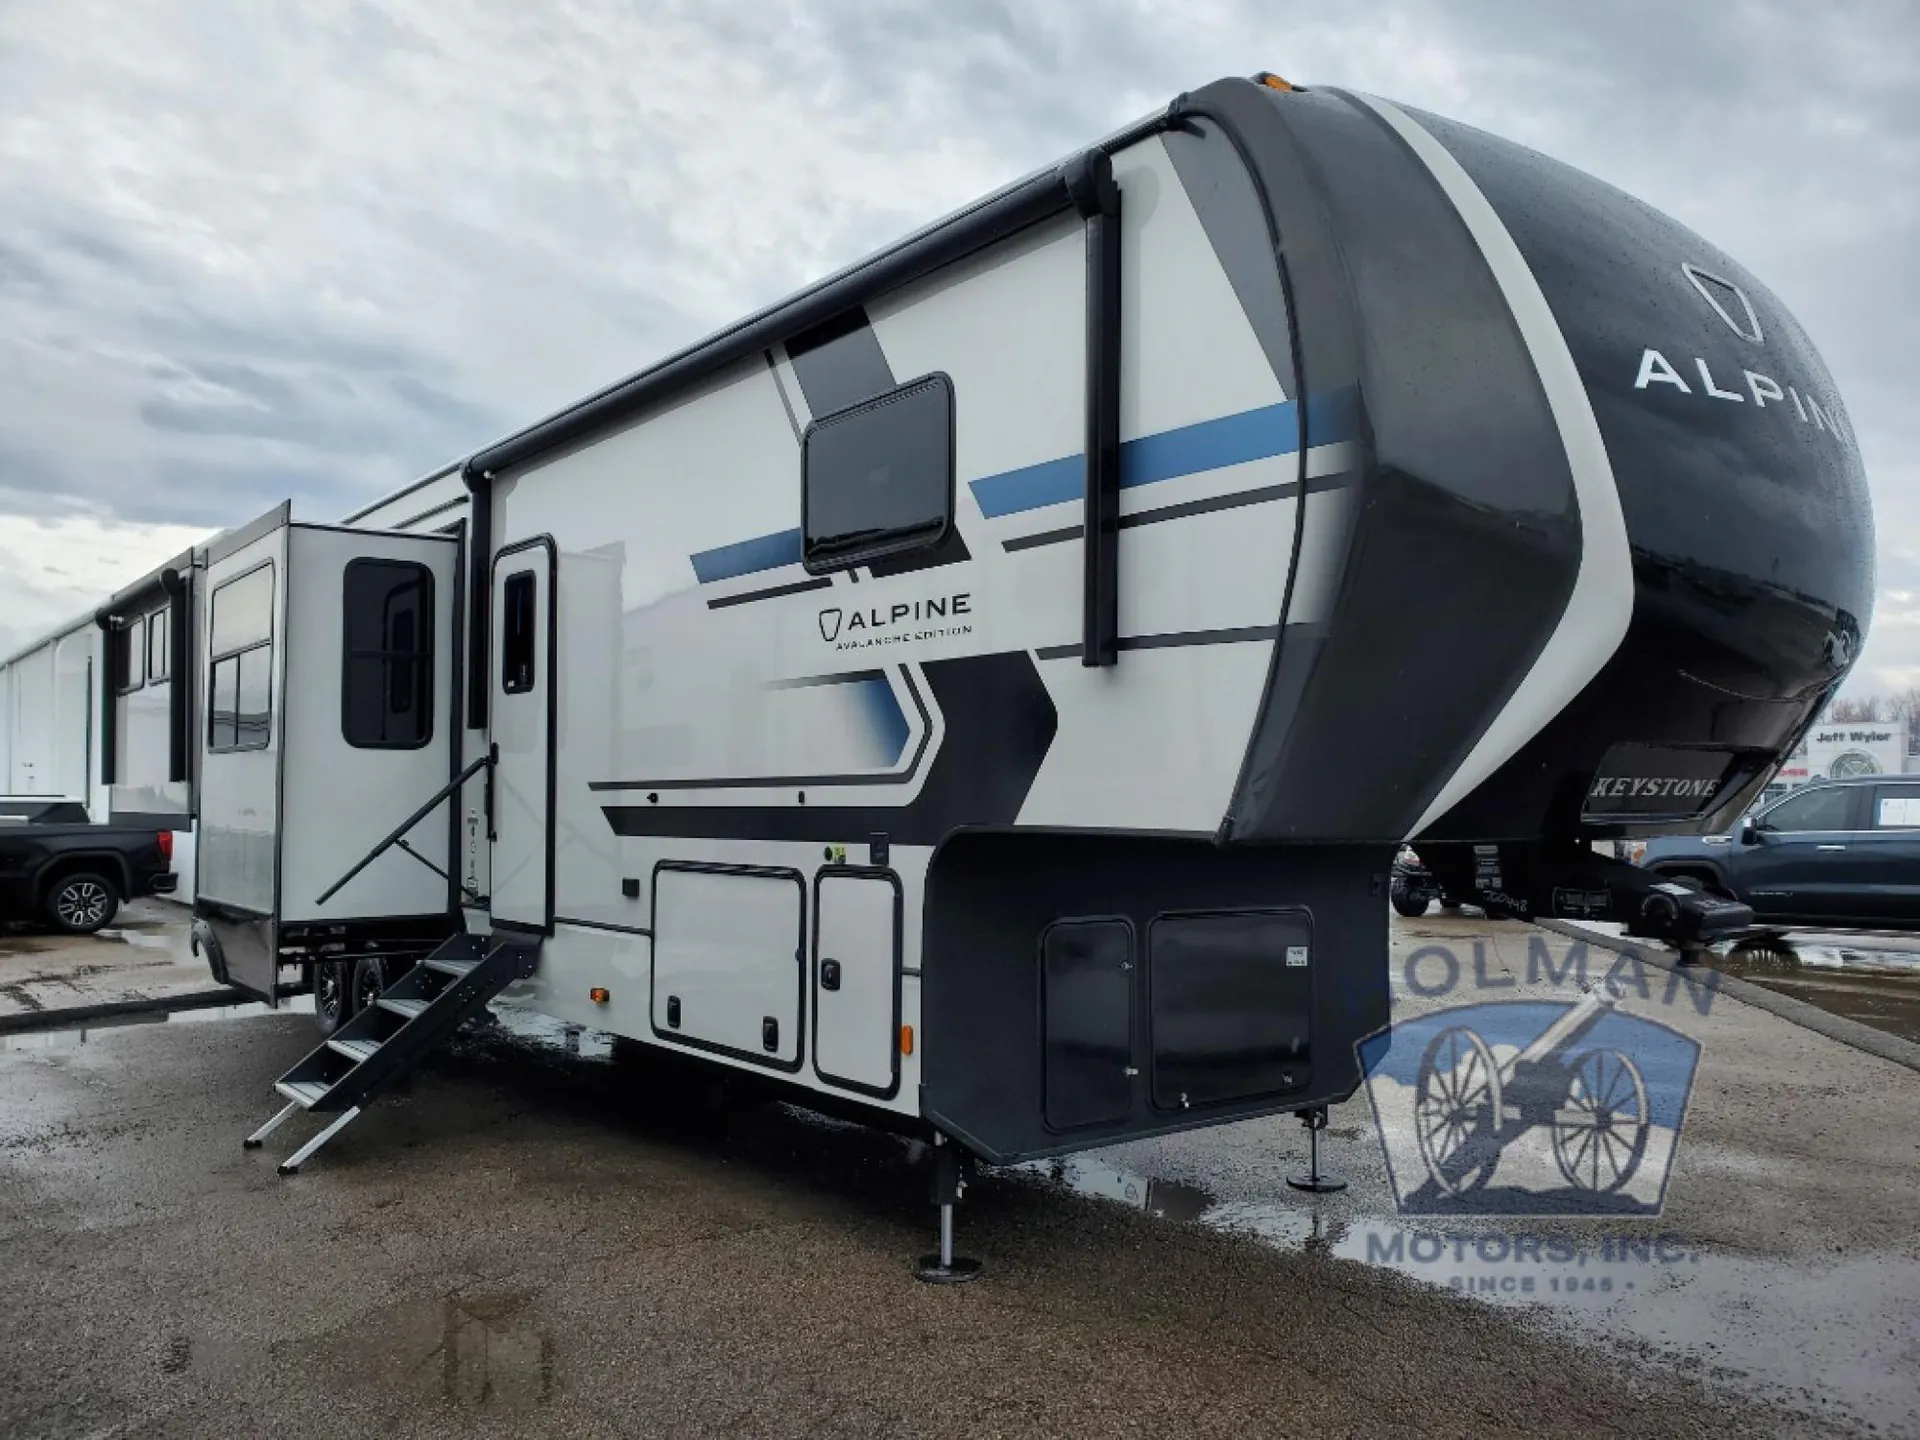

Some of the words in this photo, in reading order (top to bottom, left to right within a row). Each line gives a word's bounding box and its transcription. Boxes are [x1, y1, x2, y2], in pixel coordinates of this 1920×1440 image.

[847, 593, 972, 631] ALPINE
[836, 633, 910, 651] AVALANCHE
[914, 625, 972, 641] EDITION
[1816, 731, 1846, 743] Jeff
[1850, 731, 1891, 743] Wyler
[1589, 777, 1722, 798] KEYSTONE
